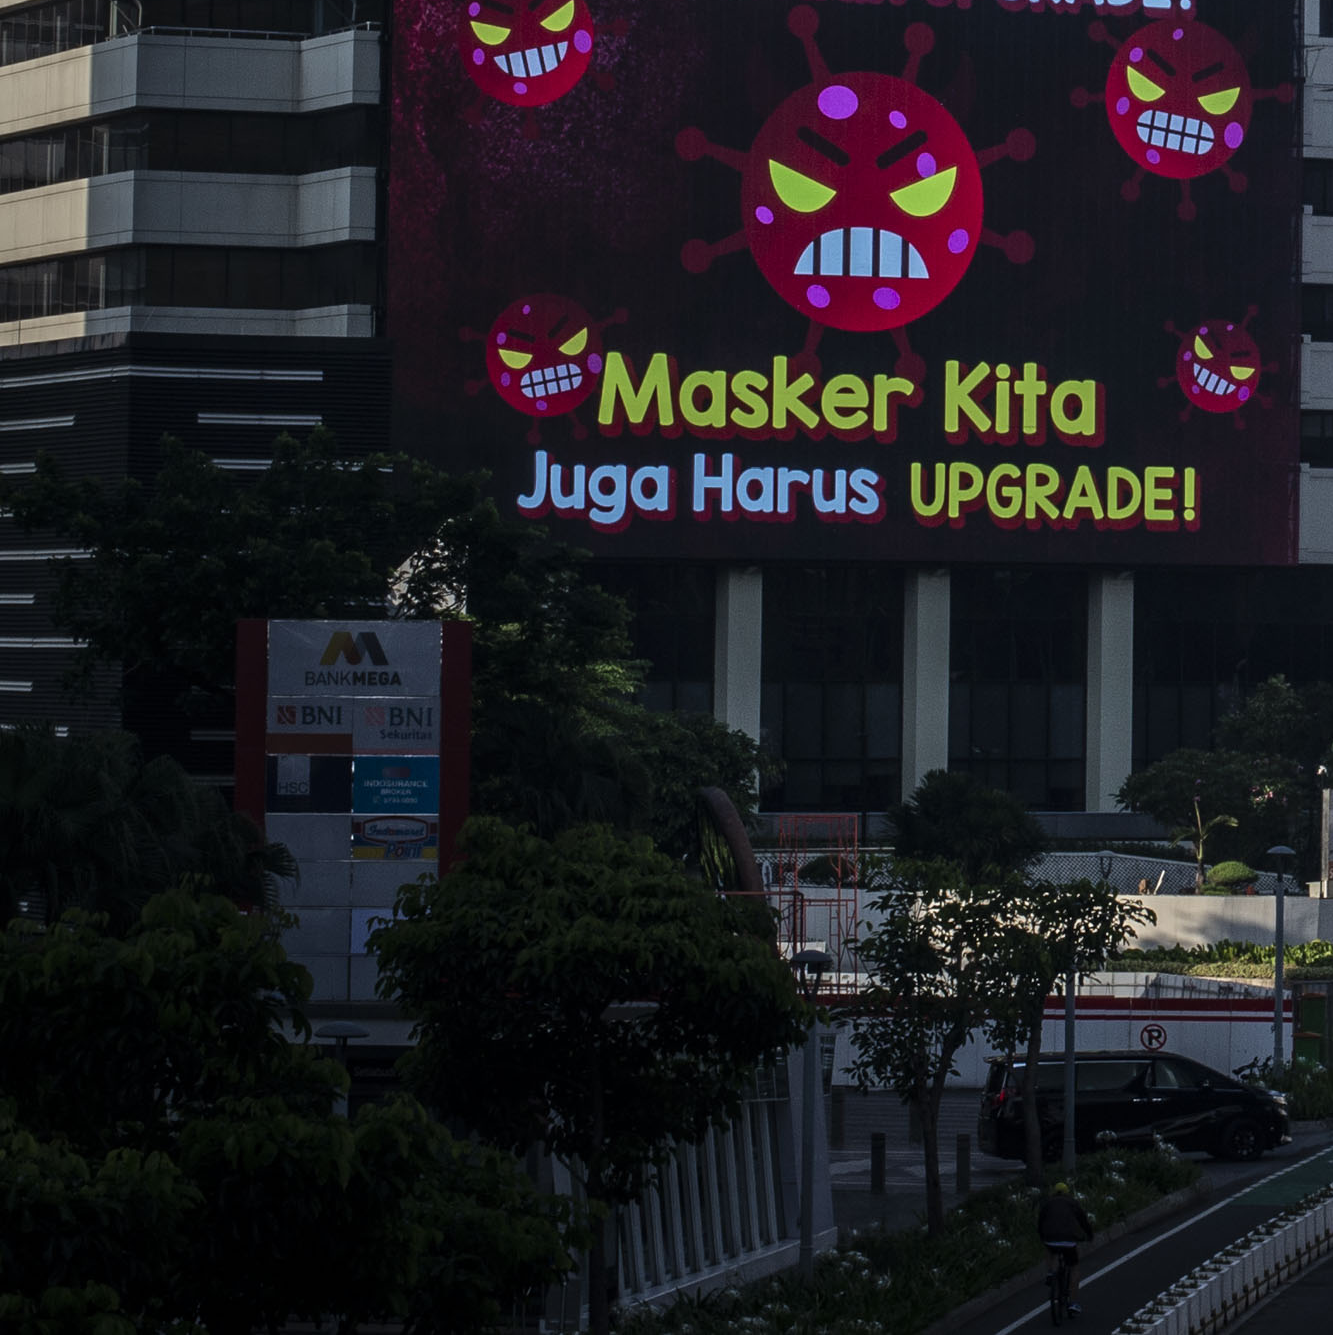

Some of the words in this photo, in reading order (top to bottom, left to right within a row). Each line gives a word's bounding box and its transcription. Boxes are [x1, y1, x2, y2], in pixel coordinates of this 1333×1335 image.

[599, 352, 914, 435] Masker
[944, 361, 1098, 436] Kita
[517, 451, 670, 524] Juga
[694, 454, 880, 515] Harus
[911, 464, 1197, 522] UPGRADE!
[301, 706, 342, 725] BNI
[389, 707, 433, 727] BNI
[386, 841, 423, 859] Point
